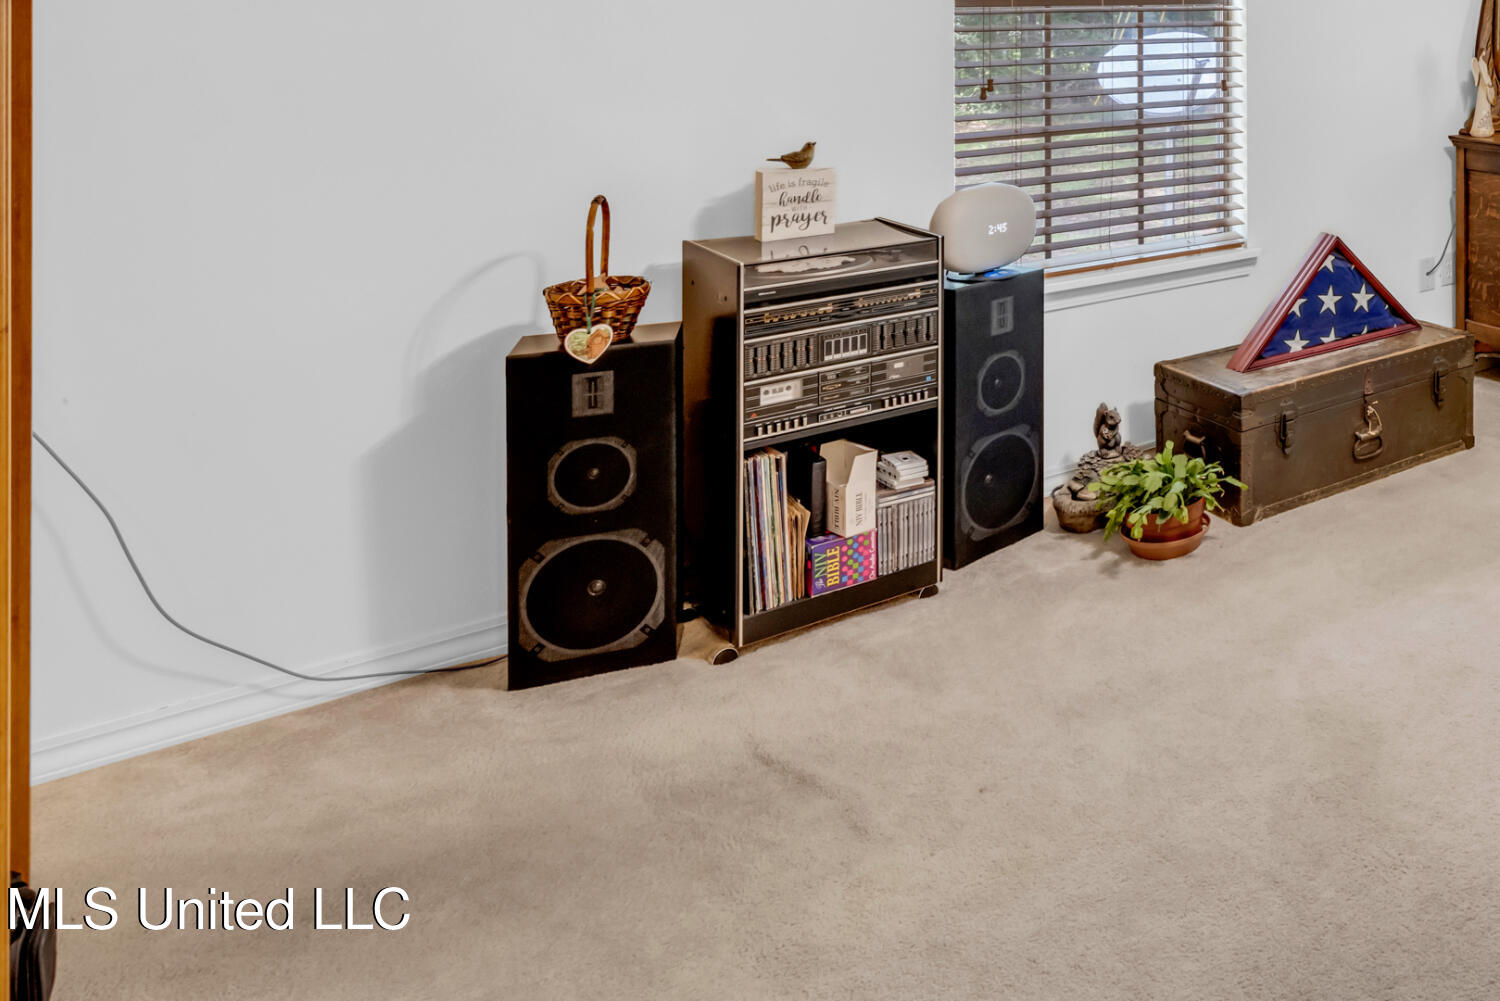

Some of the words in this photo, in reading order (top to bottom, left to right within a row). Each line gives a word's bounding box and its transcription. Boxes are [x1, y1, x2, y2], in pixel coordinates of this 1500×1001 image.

[798, 177, 829, 189] fragile
[779, 188, 822, 207] handle
[770, 210, 828, 233] prayer
[988, 222, 1008, 235] 2:45
[814, 552, 827, 579] NIV
[826, 545, 840, 588] BIBLE
